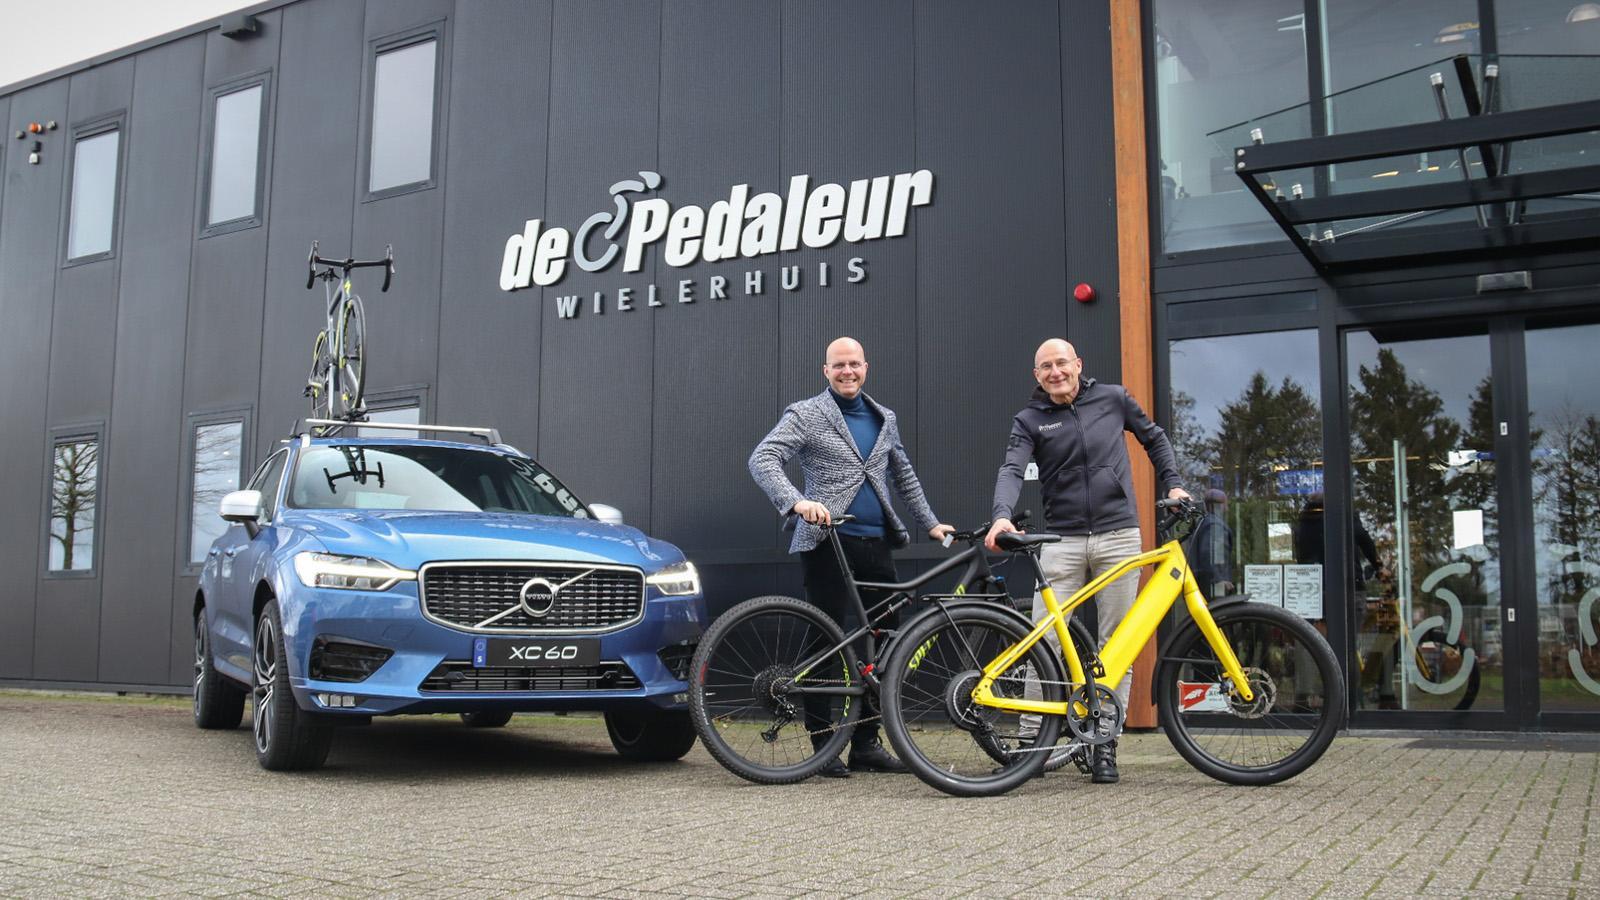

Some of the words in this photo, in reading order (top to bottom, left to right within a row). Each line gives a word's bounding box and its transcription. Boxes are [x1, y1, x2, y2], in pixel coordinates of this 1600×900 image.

[499, 218, 570, 292] de
[622, 169, 934, 273] Pedaleur
[556, 257, 867, 319] WIELERHUIS
